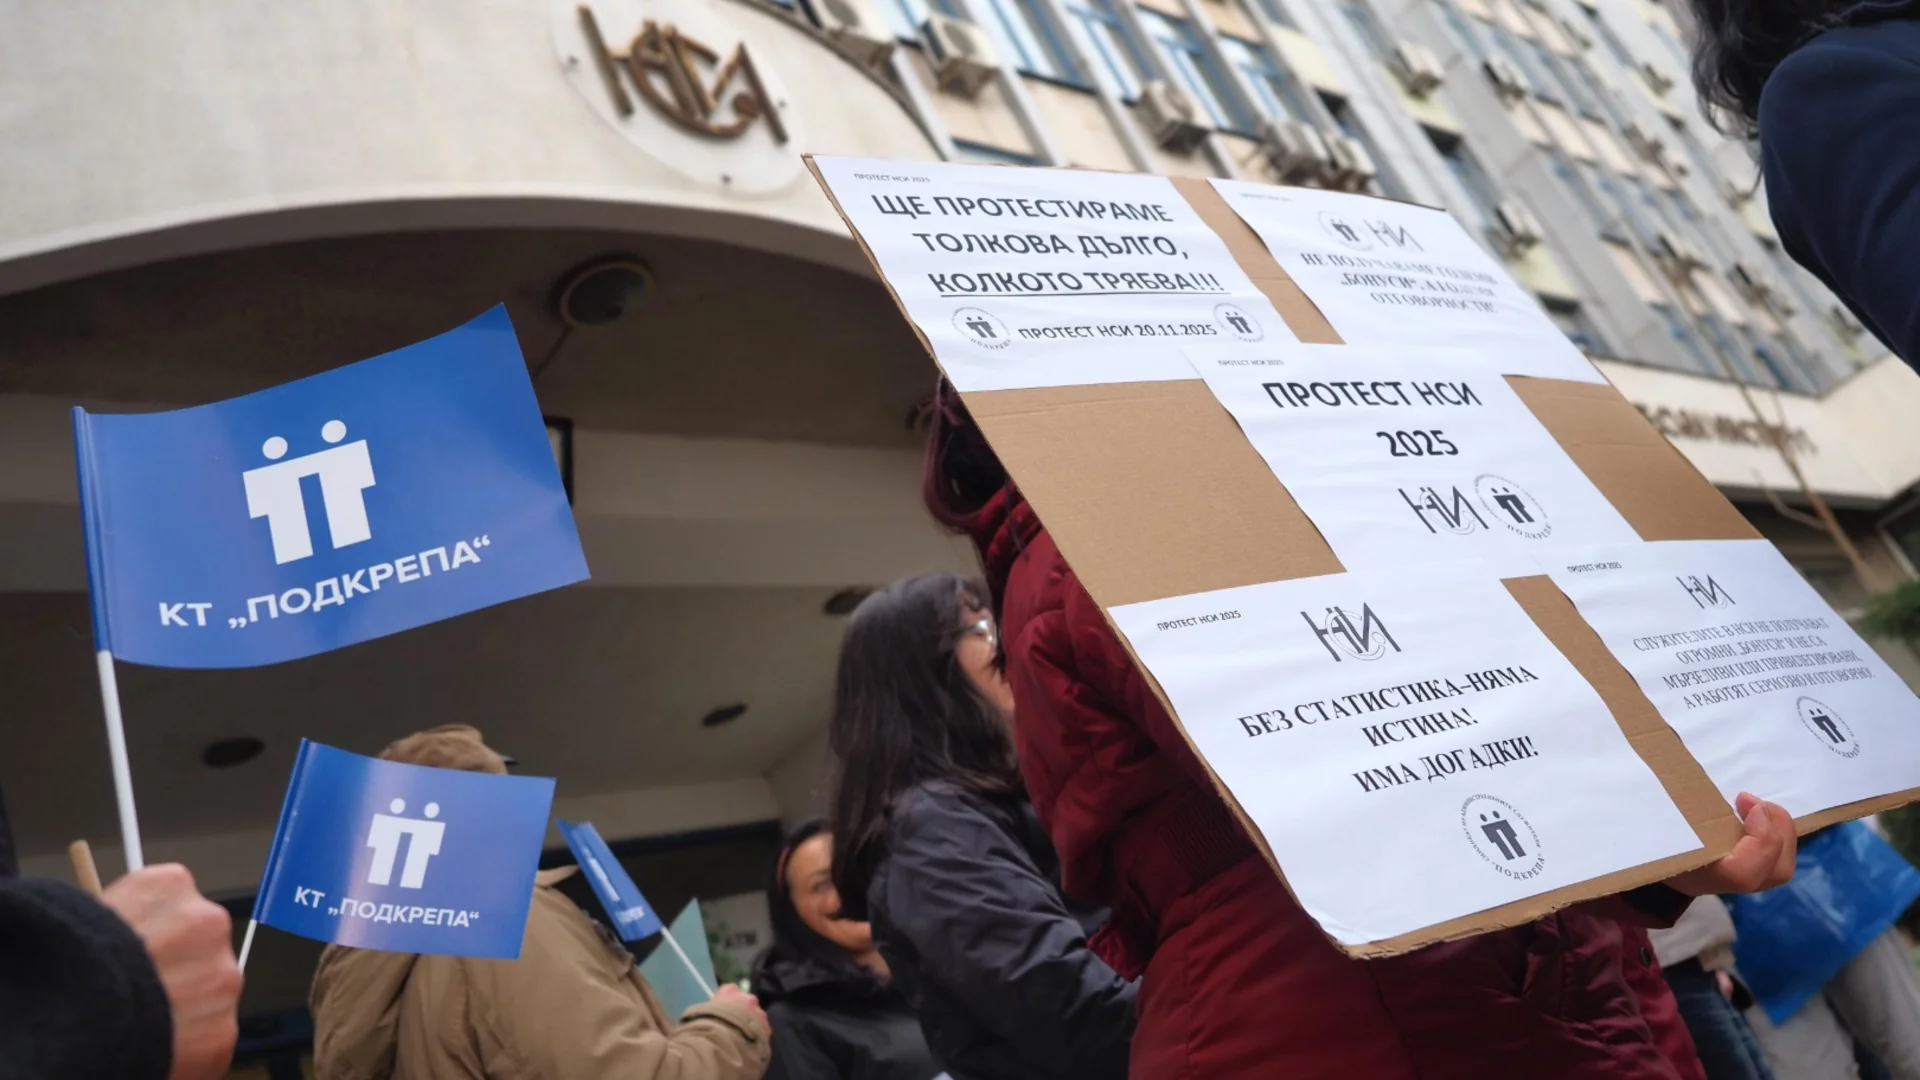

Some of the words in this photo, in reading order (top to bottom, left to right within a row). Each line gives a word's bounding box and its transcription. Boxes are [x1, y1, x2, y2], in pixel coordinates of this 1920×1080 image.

[871, 194, 931, 219] ЩЕ
[933, 196, 1174, 222] ПРОТЕСТИРАМЕ
[913, 232, 1074, 255] ТОЛКОВА
[1082, 235, 1189, 260] ДЪЛГО,
[1301, 253, 1327, 265] НЕ
[928, 272, 1082, 293] КОЛКОТО
[1083, 272, 1225, 292] ТРЯБВА!!!
[1018, 326, 1095, 339] ПРОТЕСТ
[1098, 325, 1133, 337] НСИ
[1134, 324, 1217, 337] 20.11.2025
[1262, 382, 1412, 408] ПРОТЕСТ
[1411, 382, 1483, 406] НСИ
[1376, 430, 1459, 457] 2025
[158, 602, 212, 627] КТ
[228, 534, 491, 629] „ПОДКРЕПА“
[1157, 616, 1198, 631] ПРОТЕСТ
[1198, 614, 1219, 624] НСИ
[1219, 610, 1241, 620] 2025
[1633, 627, 1726, 651] СЛУЖИТЕЛИТЕ
[1720, 626, 1734, 637] В
[1730, 622, 1760, 635] НСИ
[1754, 621, 1774, 633] НЕ
[1676, 643, 1736, 665] ОГРОМНИ
[1784, 637, 1798, 649] И
[1793, 636, 1813, 648] НЕ
[1808, 635, 1828, 646] СА
[1662, 665, 1739, 690] МЪРЗЕЛИВИ
[1735, 660, 1765, 676] ИЛИ
[1683, 696, 1697, 710] А
[1694, 683, 1750, 707] РАБОТЯТ
[1748, 674, 1807, 694] СЕРИОЗНО
[1237, 708, 1293, 738] БЕЗ
[1361, 707, 1478, 747] ИСТИНА!
[1351, 763, 1422, 793] ИМА
[1421, 736, 1539, 781] ДОГАДКИ!
[294, 885, 325, 909] КТ
[328, 897, 479, 928] „ПОДКРЕПА“
